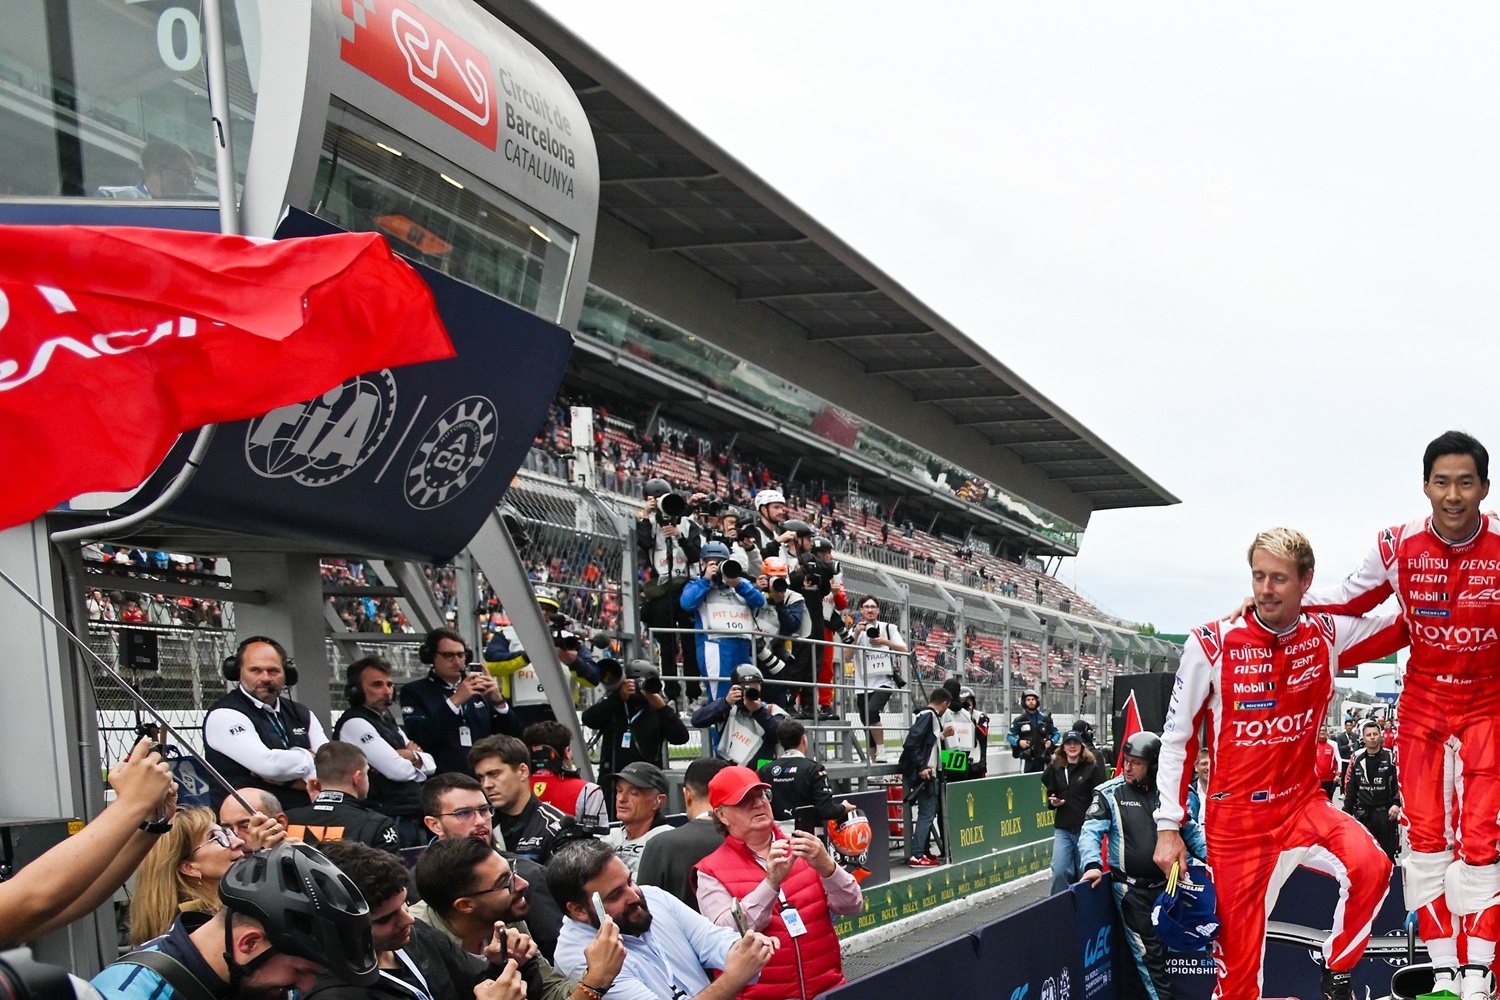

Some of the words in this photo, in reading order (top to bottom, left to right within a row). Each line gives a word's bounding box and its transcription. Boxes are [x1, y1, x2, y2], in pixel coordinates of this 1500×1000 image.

[499, 67, 553, 124] Circuit
[553, 105, 572, 137] de
[505, 102, 576, 169] Barcelona
[504, 139, 574, 199] CATALUNYA
[1408, 556, 1449, 572] FUJITSU
[1410, 574, 1448, 584] AISIN
[1468, 575, 1496, 585] ZENT
[1409, 590, 1438, 602] Mobil
[712, 611, 728, 620] PIT
[729, 610, 751, 621] LANE
[725, 621, 744, 631] 100
[1414, 620, 1498, 644] TOYOTA
[1229, 645, 1273, 662] FUJITSU
[1284, 637, 1320, 655] DENSO
[865, 652, 891, 662] TRACK
[871, 661, 886, 669] 171
[1291, 654, 1315, 670] ZENT
[518, 669, 536, 680] PIT
[1234, 663, 1273, 675] AISIN
[1286, 664, 1323, 685] WEC
[1233, 682, 1264, 693] Mobil
[229, 725, 247, 736] FIA
[1232, 708, 1314, 738] TOYOTA
[731, 730, 753, 747] ANE
[948, 752, 967, 770] 10
[1120, 800, 1142, 808] OFFICIAL
[1000, 817, 1022, 837] ROLEX
[1036, 809, 1056, 829] ROLEX
[960, 825, 984, 847] ROLEX
[940, 888, 955, 901] ROLEX
[881, 906, 899, 922] ROLEX
[902, 902, 919, 915] ROLEX
[858, 913, 876, 929] ROLEX
[1084, 925, 1112, 968] WEC
